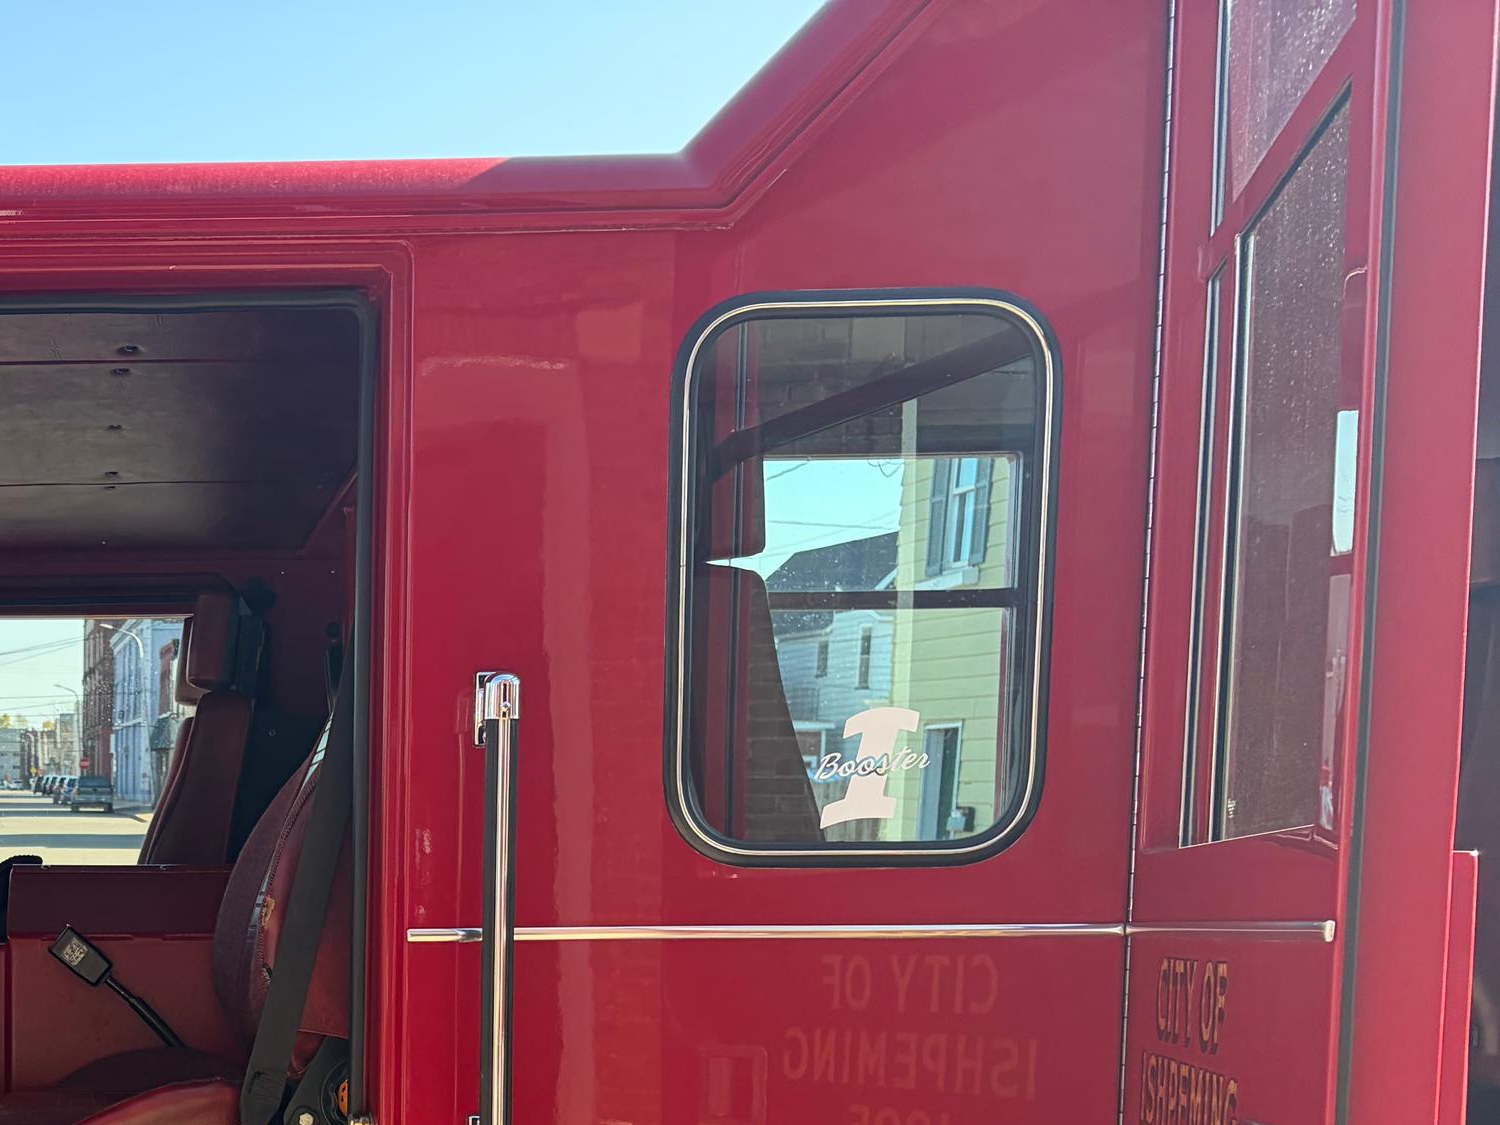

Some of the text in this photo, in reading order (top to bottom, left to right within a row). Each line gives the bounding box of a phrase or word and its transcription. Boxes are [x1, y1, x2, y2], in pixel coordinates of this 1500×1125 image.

[814, 746, 930, 780] Booster
[1156, 957, 1228, 1054] CITY OF
